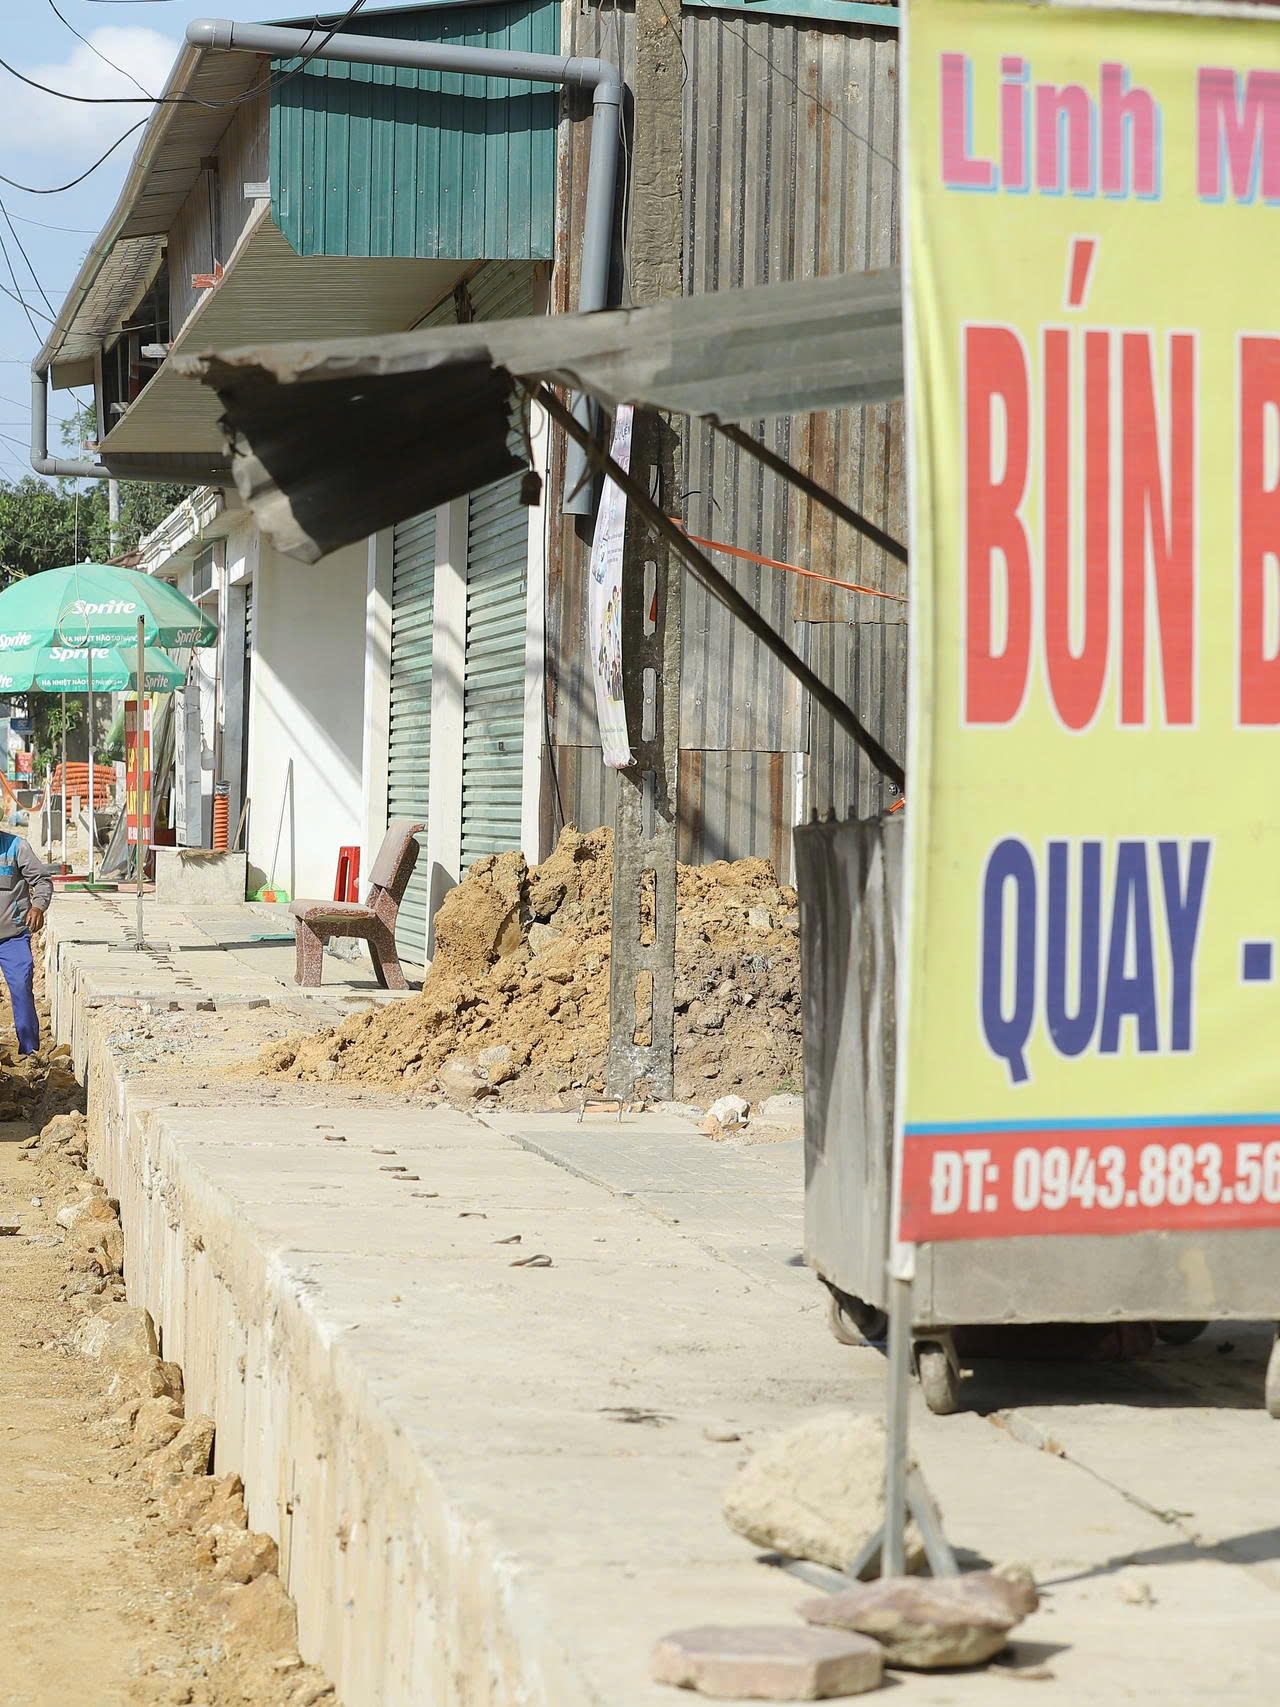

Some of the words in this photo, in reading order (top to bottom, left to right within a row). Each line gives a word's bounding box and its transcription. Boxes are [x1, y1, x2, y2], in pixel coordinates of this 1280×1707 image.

[940, 52, 1162, 201] Linh
[964, 239, 1197, 733] BÚN
[71, 599, 137, 617] Sprite
[175, 628, 202, 646] Sprite
[144, 674, 169, 690] Sprite
[980, 838, 1212, 1084] QUAY
[930, 1149, 1000, 1215] ĐT:
